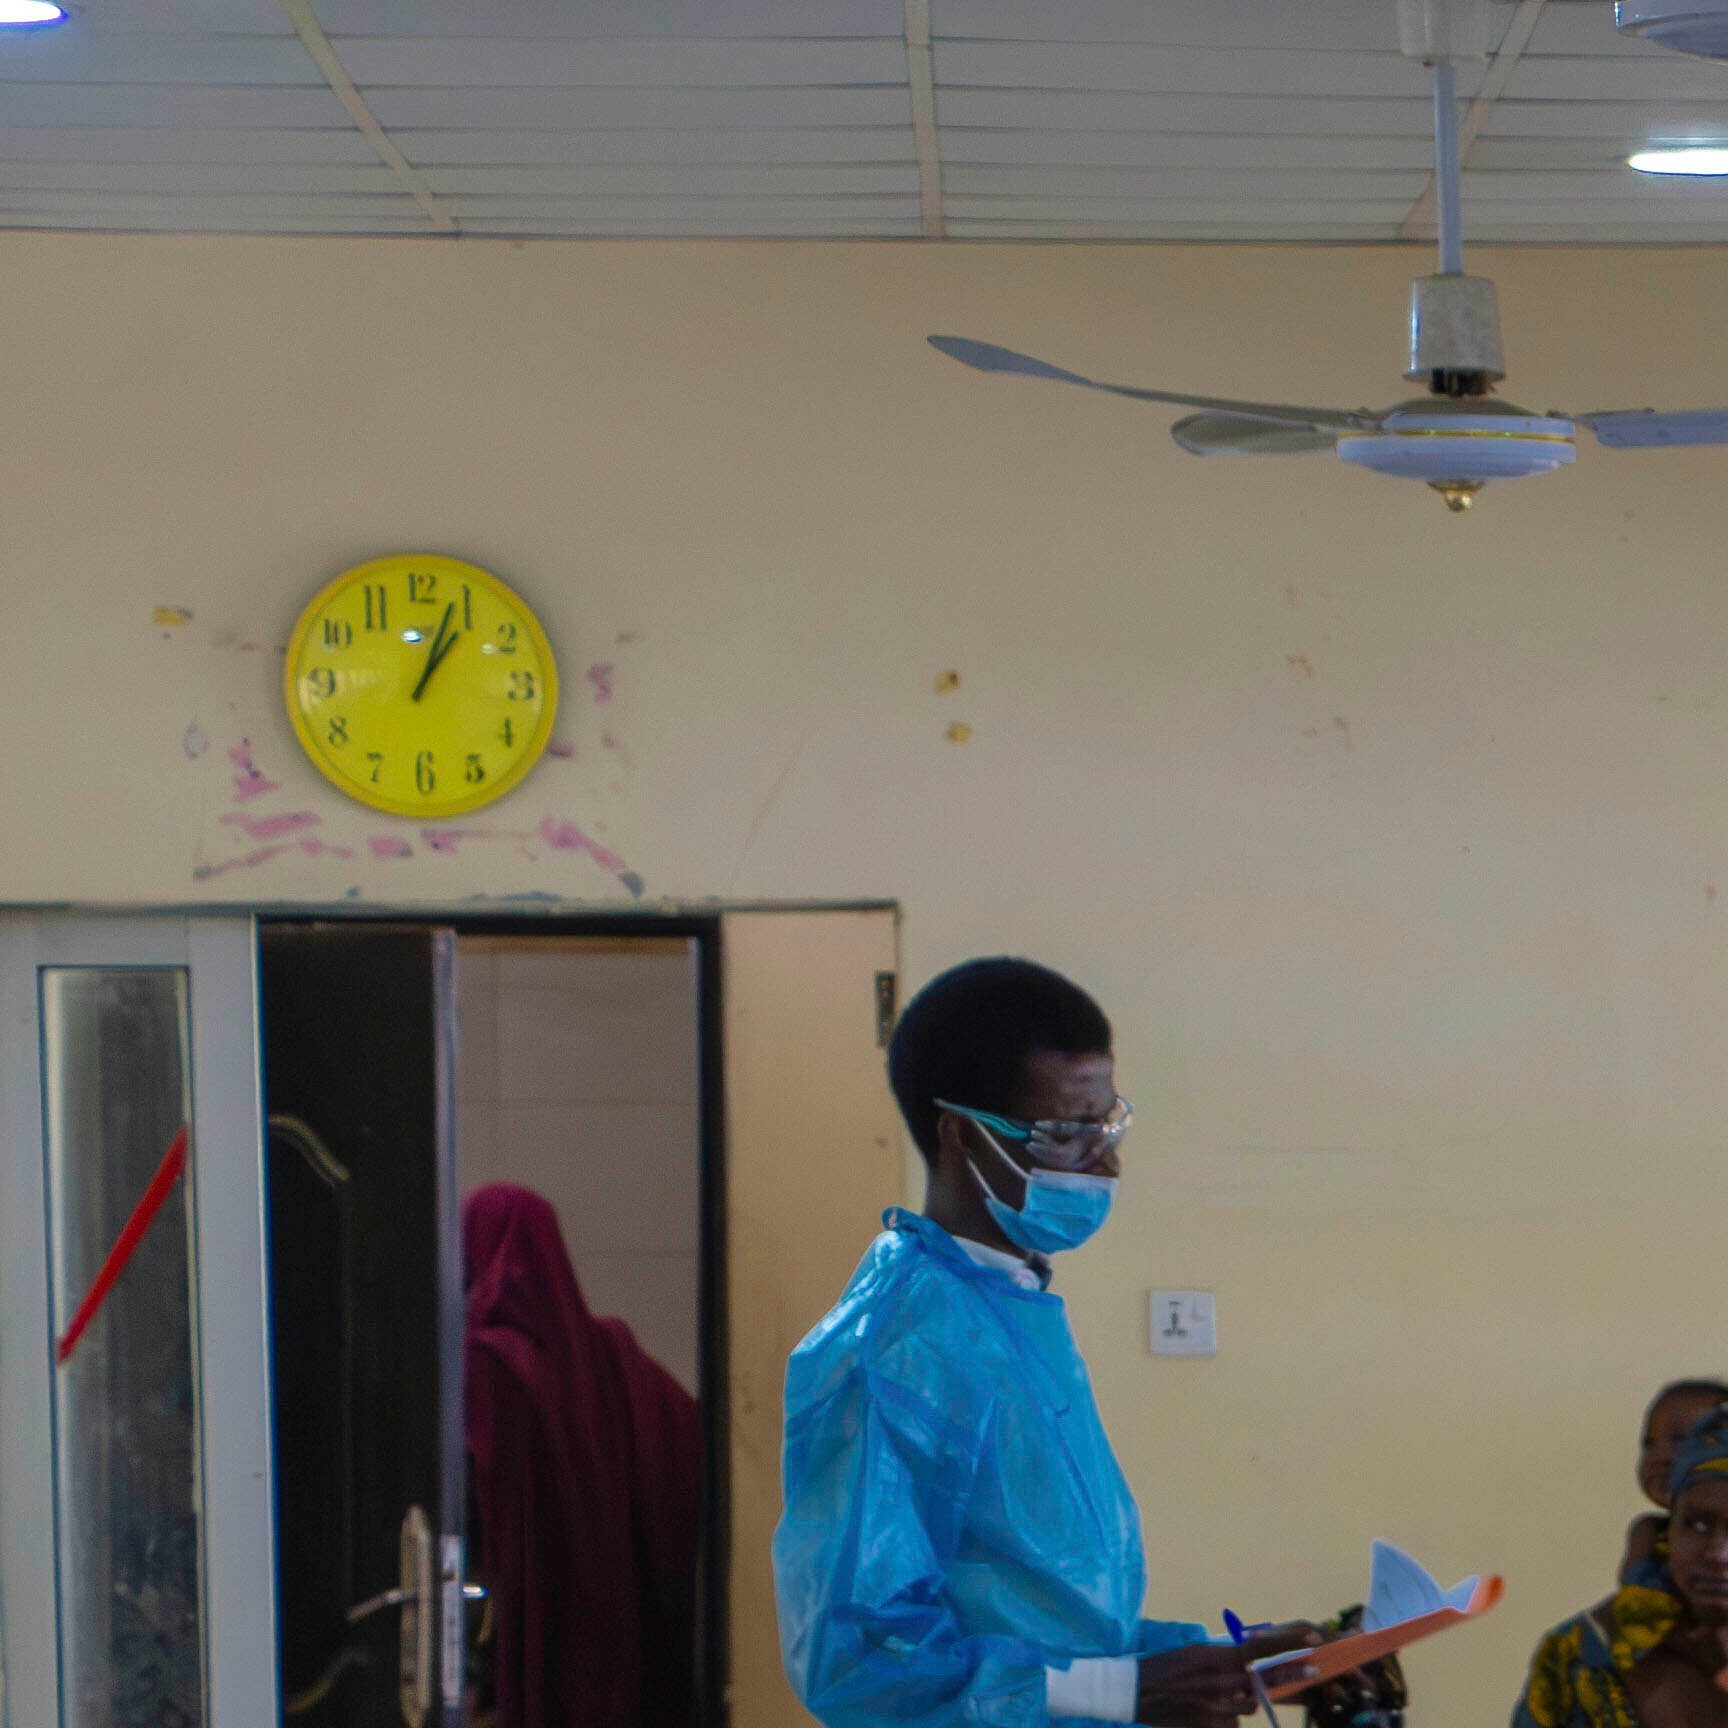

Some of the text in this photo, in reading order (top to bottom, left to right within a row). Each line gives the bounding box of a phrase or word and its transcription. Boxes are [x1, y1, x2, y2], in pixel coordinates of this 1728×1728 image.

[408, 573, 436, 604] 12
[363, 584, 387, 631] 11
[462, 584, 471, 630] 1
[323, 618, 352, 648] 10
[497, 623, 517, 653] 2
[308, 666, 336, 698] 9
[508, 670, 534, 700] 3
[328, 715, 348, 748] 8
[498, 717, 513, 748] 4
[366, 752, 384, 782] 7
[415, 751, 435, 794] 6
[465, 754, 486, 783] 5
